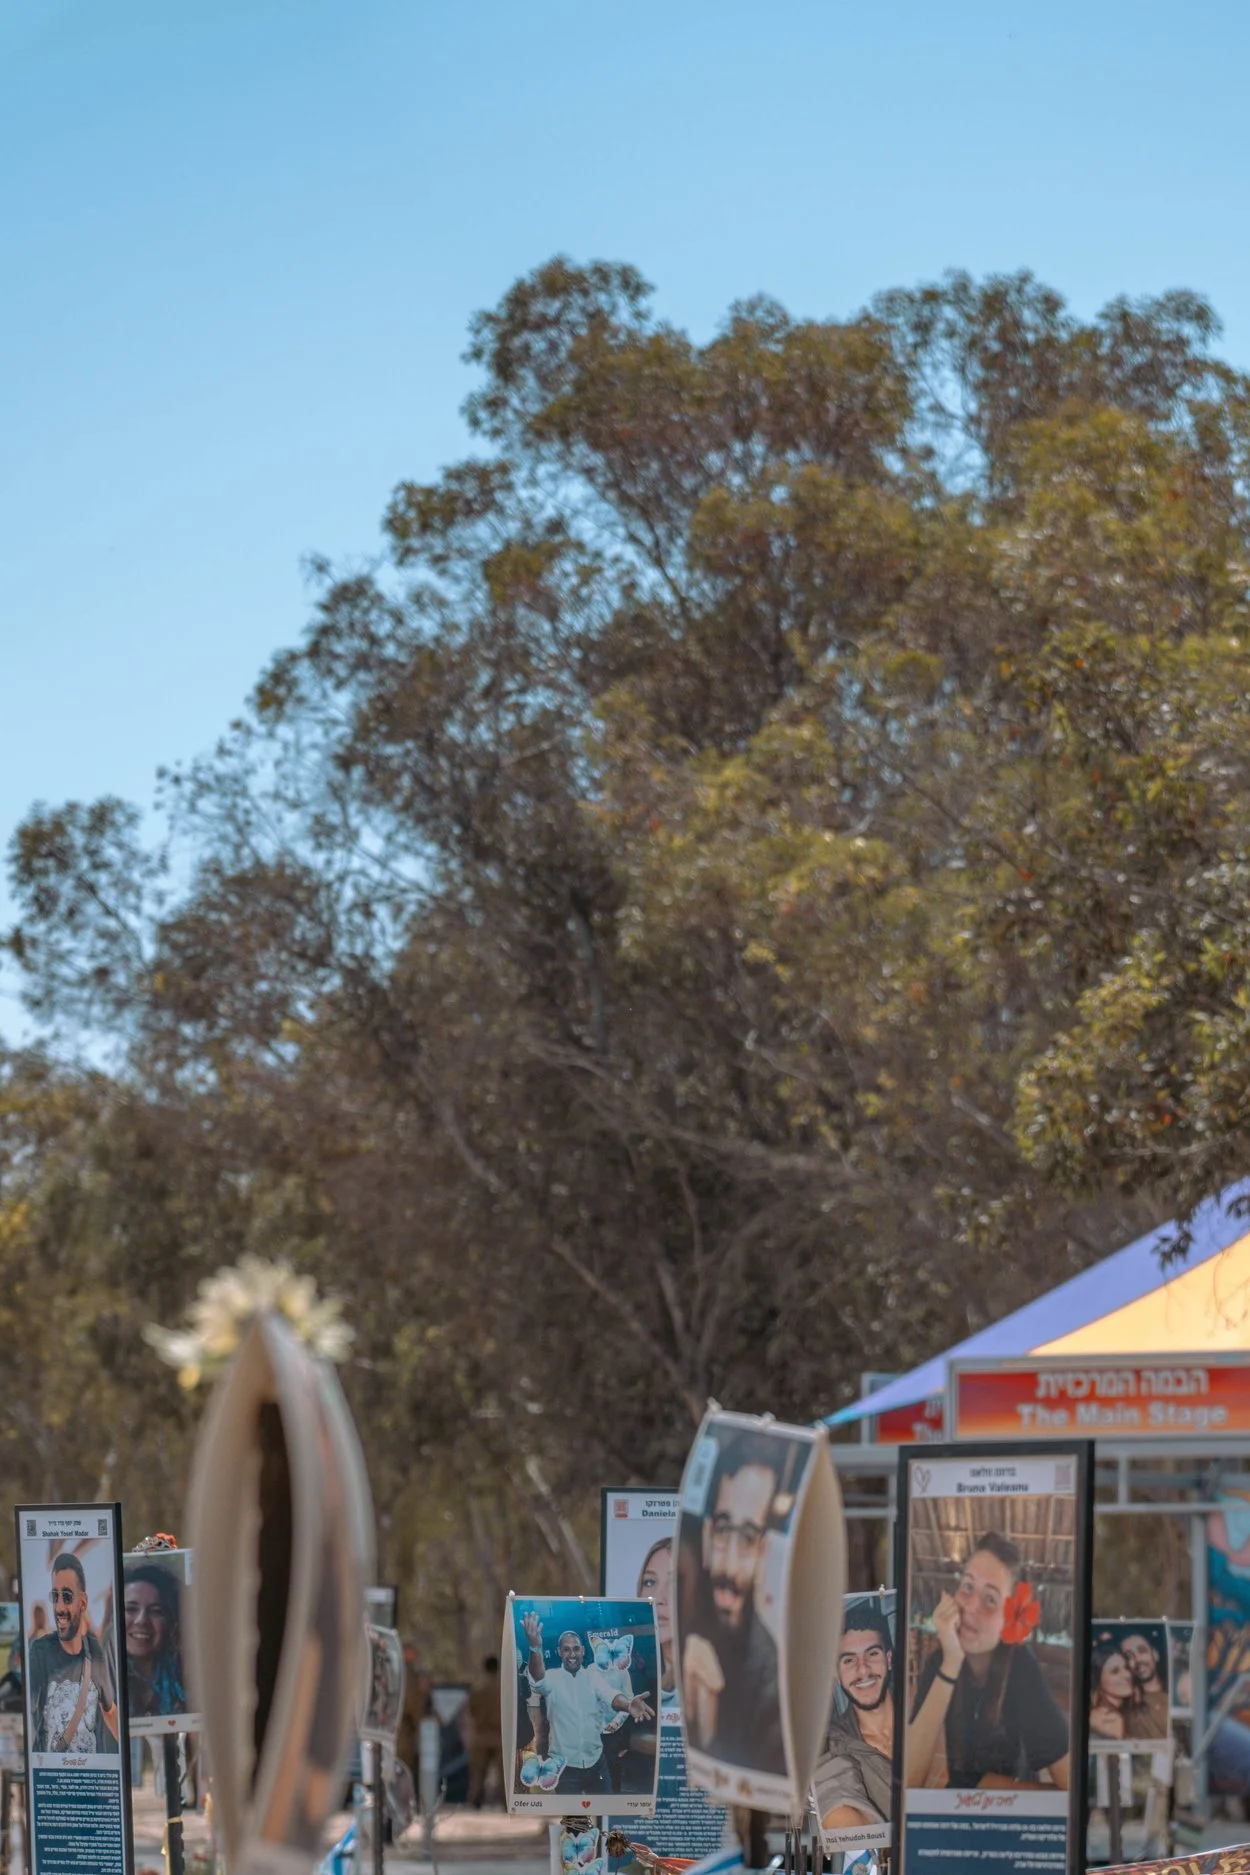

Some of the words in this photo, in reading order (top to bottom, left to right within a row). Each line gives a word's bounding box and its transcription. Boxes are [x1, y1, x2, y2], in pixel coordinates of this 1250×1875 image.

[1036, 1370, 1137, 1398] המרכזית
[1141, 1368, 1209, 1395] הבמה
[1016, 1404, 1069, 1428] The
[1075, 1402, 1141, 1426] Main
[1148, 1401, 1229, 1429] Stage
[956, 1483, 986, 1493] Bruna
[642, 1509, 676, 1517] Daniela
[587, 1628, 619, 1638] Emerald
